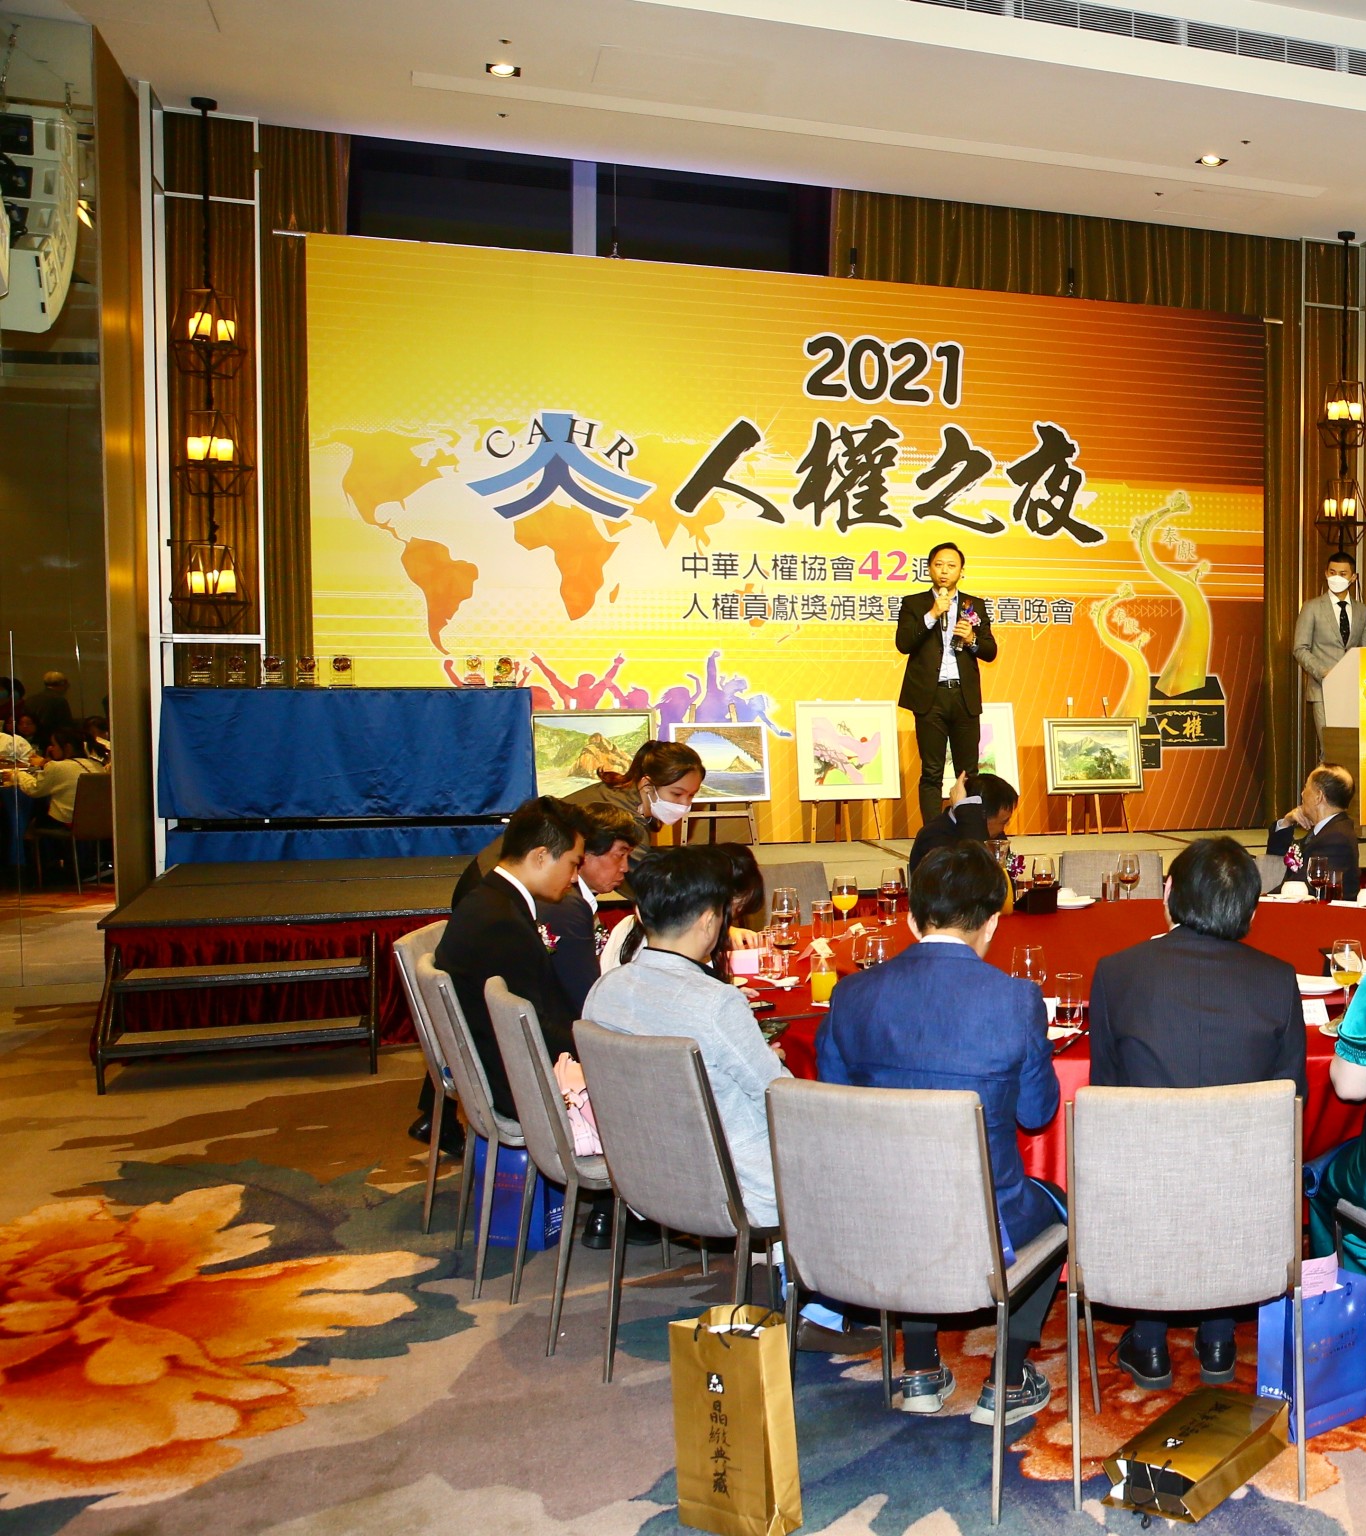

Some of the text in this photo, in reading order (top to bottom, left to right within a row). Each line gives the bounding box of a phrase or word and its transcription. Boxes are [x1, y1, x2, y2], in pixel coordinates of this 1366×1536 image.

[805, 334, 961, 406] 2021
[485, 417, 635, 471] CAHR
[674, 416, 1105, 544] 人權之夜
[1158, 715, 1205, 740] 人權
